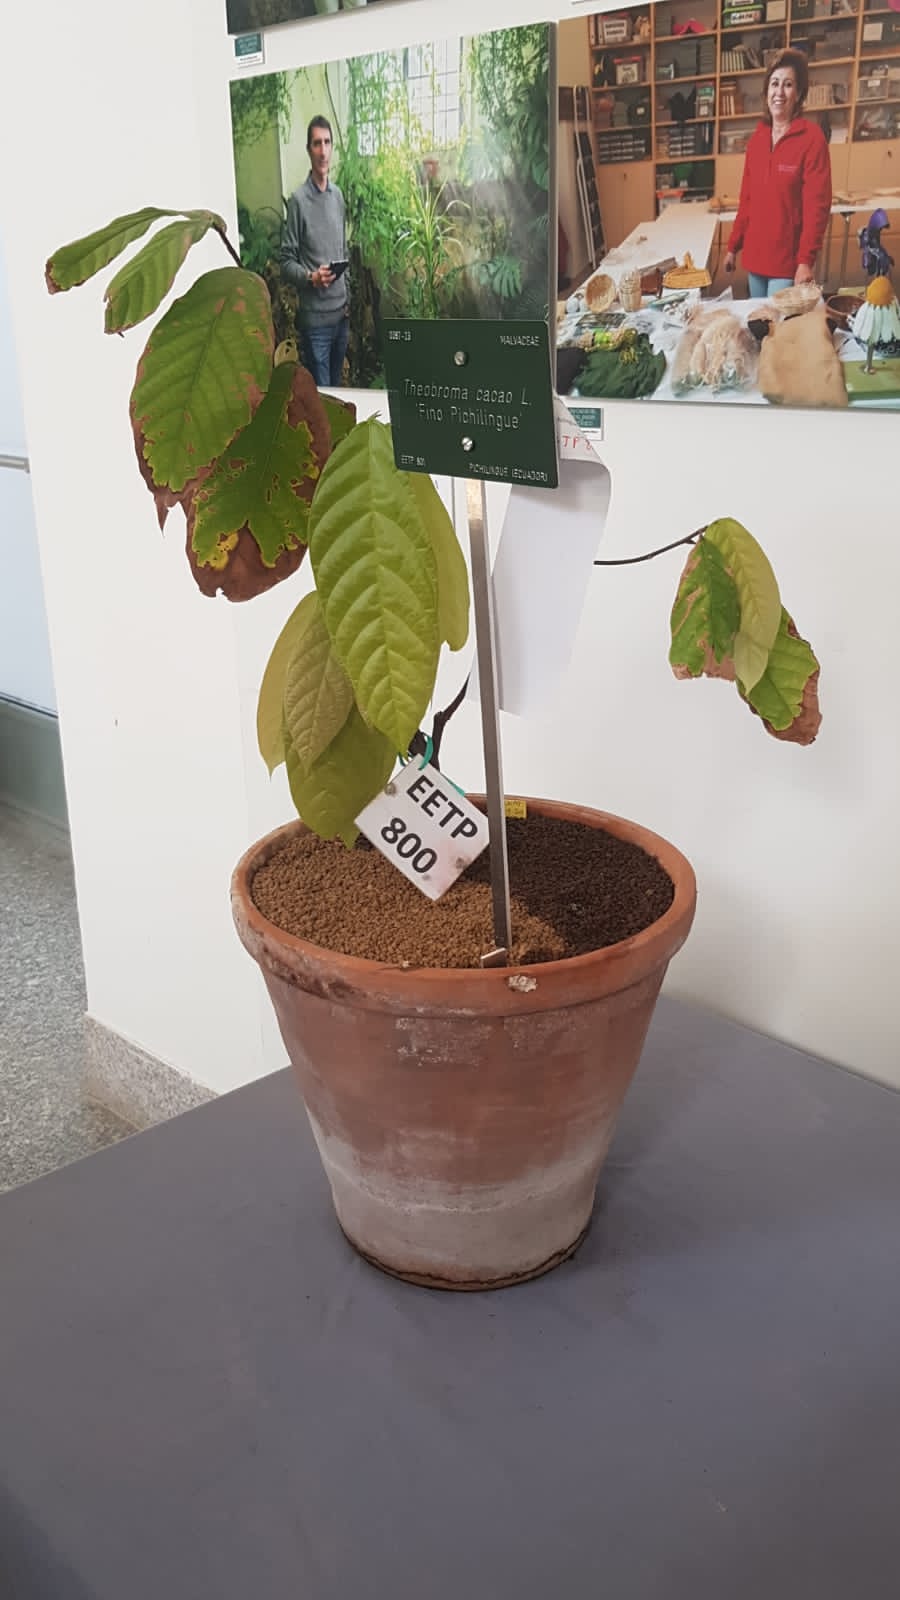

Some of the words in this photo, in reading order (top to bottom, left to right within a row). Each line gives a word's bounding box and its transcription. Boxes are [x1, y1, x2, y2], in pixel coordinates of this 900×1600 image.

[499, 335, 540, 346] MALVACEAE
[404, 378, 468, 400] Theobroma
[476, 388, 513, 404] cacao
[521, 387, 532, 406] L.
[415, 402, 443, 421] 'Fino
[450, 405, 523, 432] Pichilingue'
[400, 454, 415, 464] EETP
[468, 462, 508, 477] PICHILINGUE
[406, 775, 478, 839] EETP
[380, 817, 438, 873] 800
